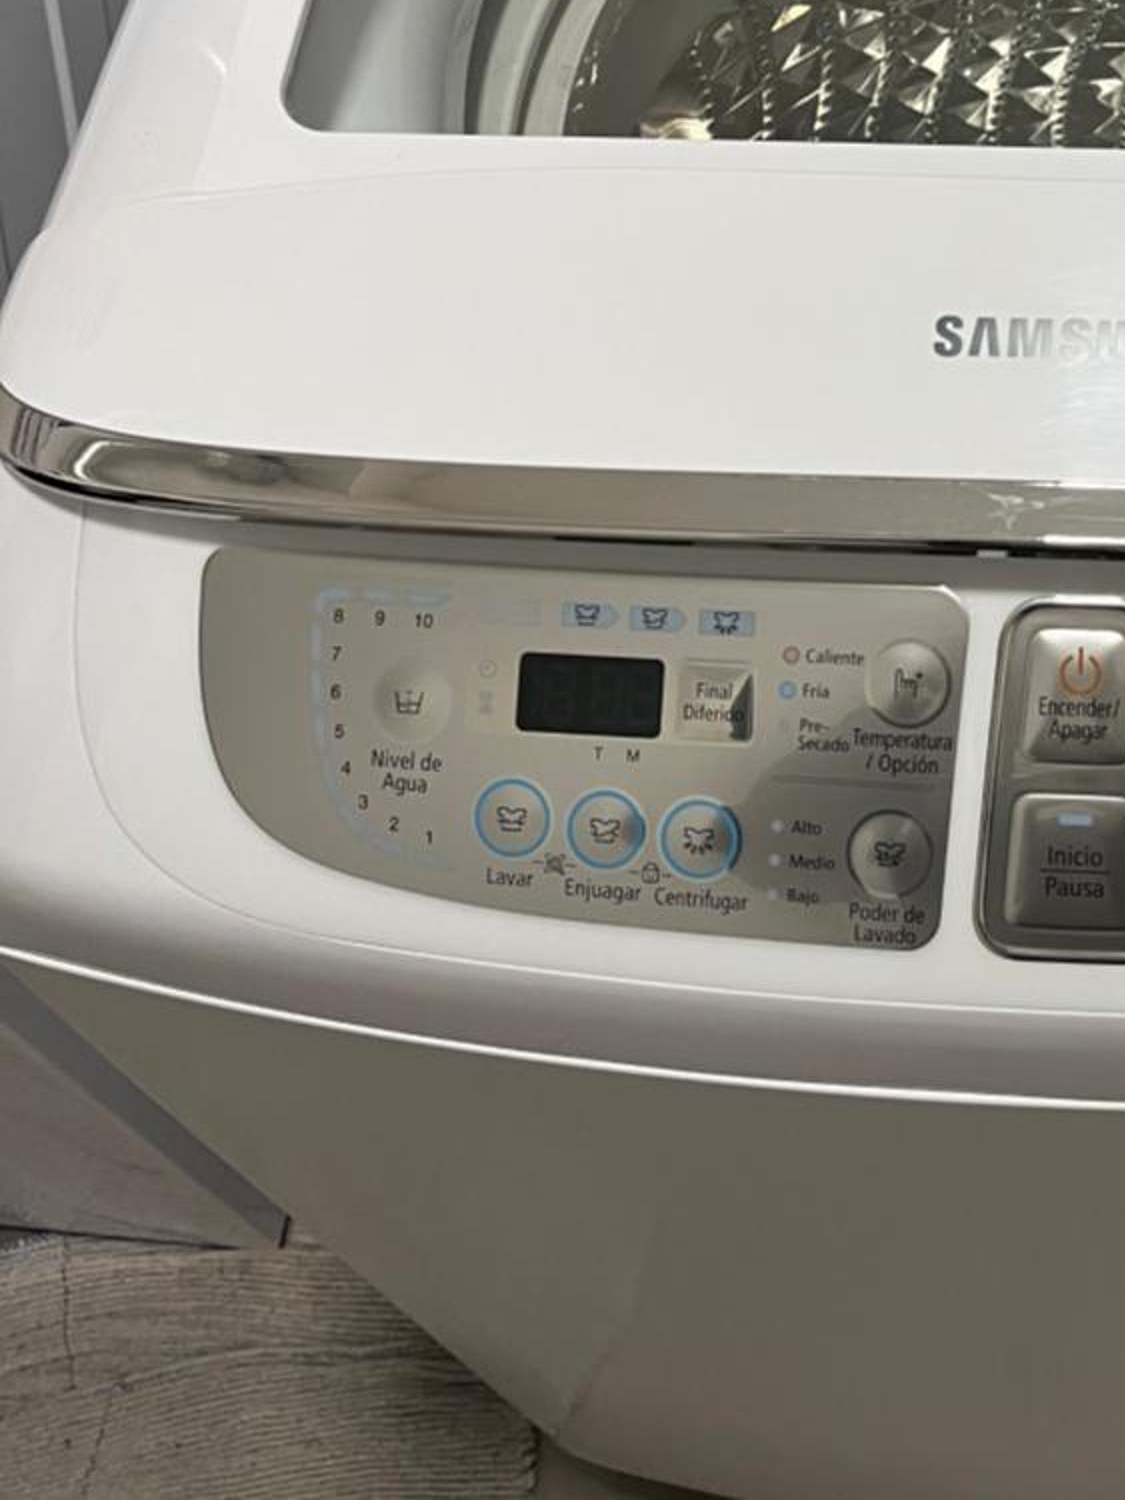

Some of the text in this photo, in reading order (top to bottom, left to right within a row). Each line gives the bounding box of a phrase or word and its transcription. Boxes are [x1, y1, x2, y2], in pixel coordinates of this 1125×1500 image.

[333, 608, 434, 629] 8 9 10
[332, 647, 342, 661] 7
[805, 649, 864, 666] Caliente
[330, 684, 341, 700] 6
[696, 682, 733, 700] Final
[683, 704, 745, 723] Diferido
[1038, 696, 1121, 718] Encender/
[334, 724, 345, 739] 5
[853, 729, 951, 751] Temperatura
[1050, 721, 1108, 745] Apagar
[798, 735, 849, 752] Secado
[371, 749, 442, 772] Nivel de
[594, 746, 640, 762] T M
[340, 760, 351, 775] 4
[865, 754, 938, 776] / Opción
[382, 773, 427, 795] Agua
[358, 795, 369, 810] 3
[389, 817, 400, 832] 2
[791, 820, 822, 835] Alto
[426, 830, 433, 845] 1
[789, 855, 835, 871] Medio
[1047, 846, 1103, 867] Inicio
[486, 867, 533, 888] Lavar
[564, 878, 641, 904] Enjuagar
[787, 890, 819, 906] Bajo
[1045, 878, 1105, 899] Pausa
[654, 887, 748, 915] Centrifugar
[849, 902, 925, 924] Poder de
[854, 924, 916, 945] Lavado
